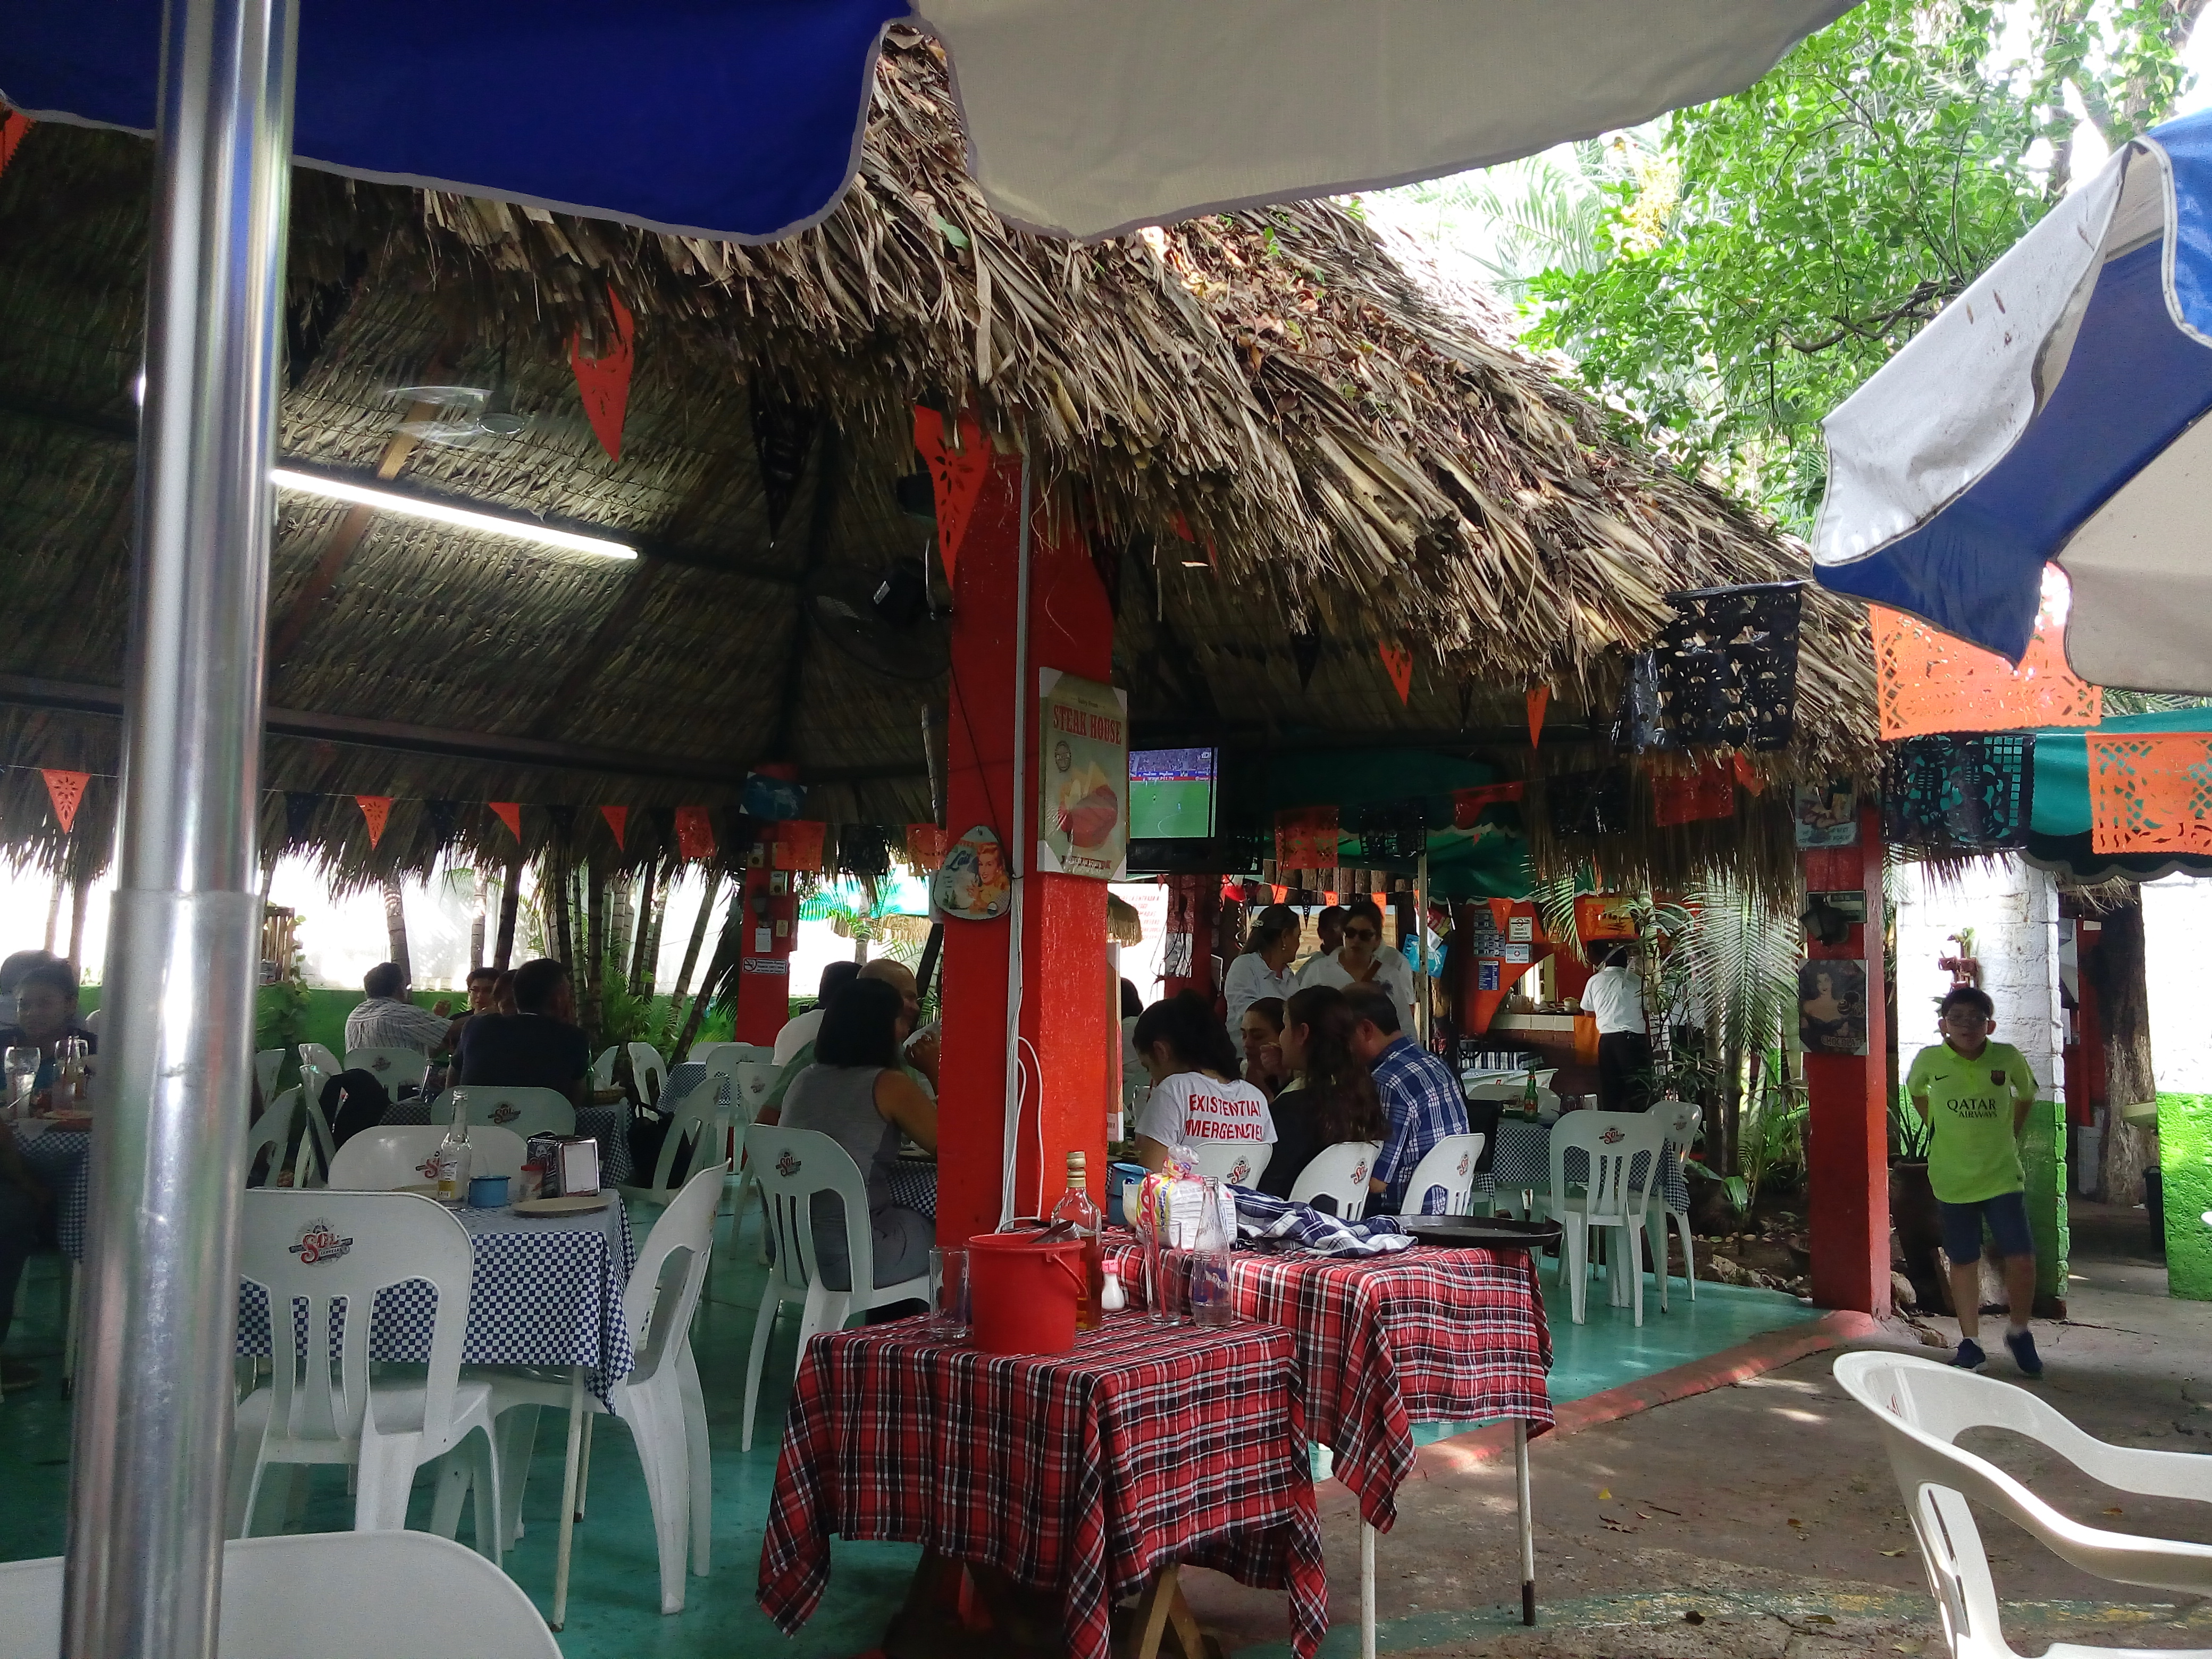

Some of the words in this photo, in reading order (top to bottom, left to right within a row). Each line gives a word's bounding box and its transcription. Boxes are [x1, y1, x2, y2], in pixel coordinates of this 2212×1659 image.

[1053, 704, 1087, 736] STEAK
[1090, 714, 1121, 745] HOUSE
[1947, 1099, 1996, 1113] QATAR
[1231, 1164, 1247, 1185] SOL
[300, 1233, 339, 1264] SOL
